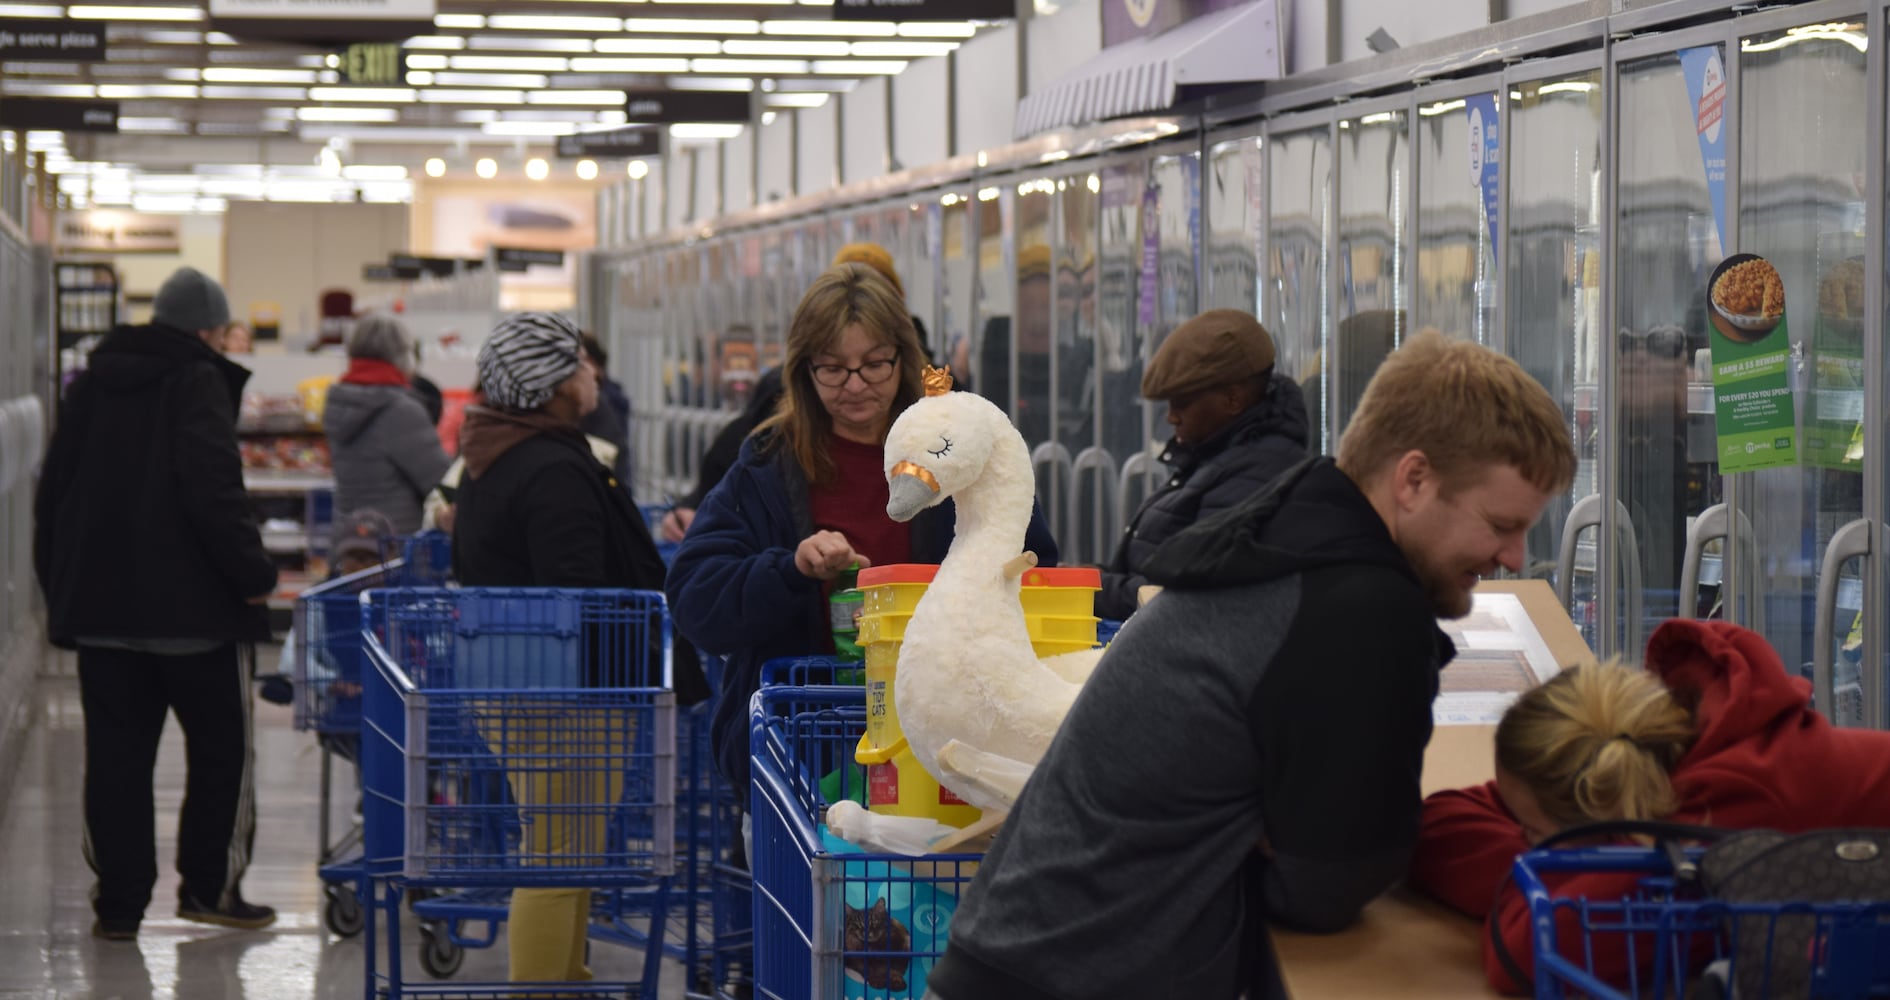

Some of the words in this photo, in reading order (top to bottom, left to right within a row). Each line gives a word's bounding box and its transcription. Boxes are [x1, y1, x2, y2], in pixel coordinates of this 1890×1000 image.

[347, 43, 399, 82] EXIT
[1755, 354, 1785, 367] REWARD
[1719, 395, 1731, 404] FOR
[1731, 392, 1748, 402] EVERY
[1759, 389, 1771, 399] YOU
[872, 691, 885, 703] TIDY
[872, 704, 886, 717] CATS
